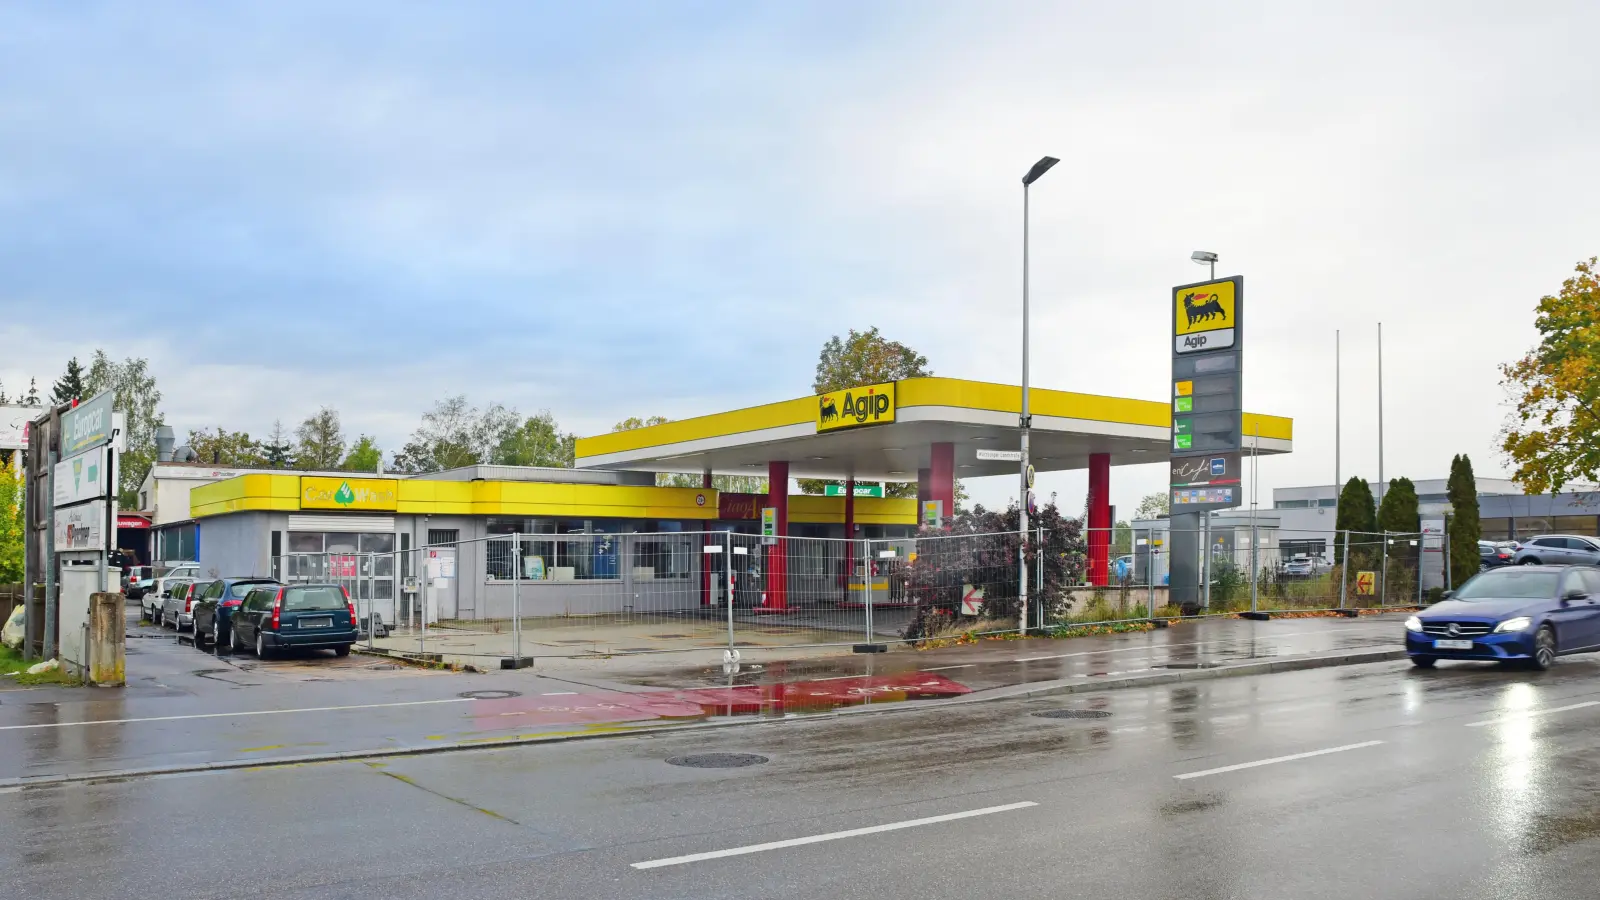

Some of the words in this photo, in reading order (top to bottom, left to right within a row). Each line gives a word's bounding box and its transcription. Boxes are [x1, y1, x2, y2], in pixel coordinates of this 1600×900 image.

[1184, 334, 1207, 349] Agip
[842, 388, 889, 423] Agip
[73, 407, 104, 441] Europcar
[304, 485, 334, 503] Car
[354, 487, 396, 503] Wash
[837, 486, 872, 496] Eupcar
